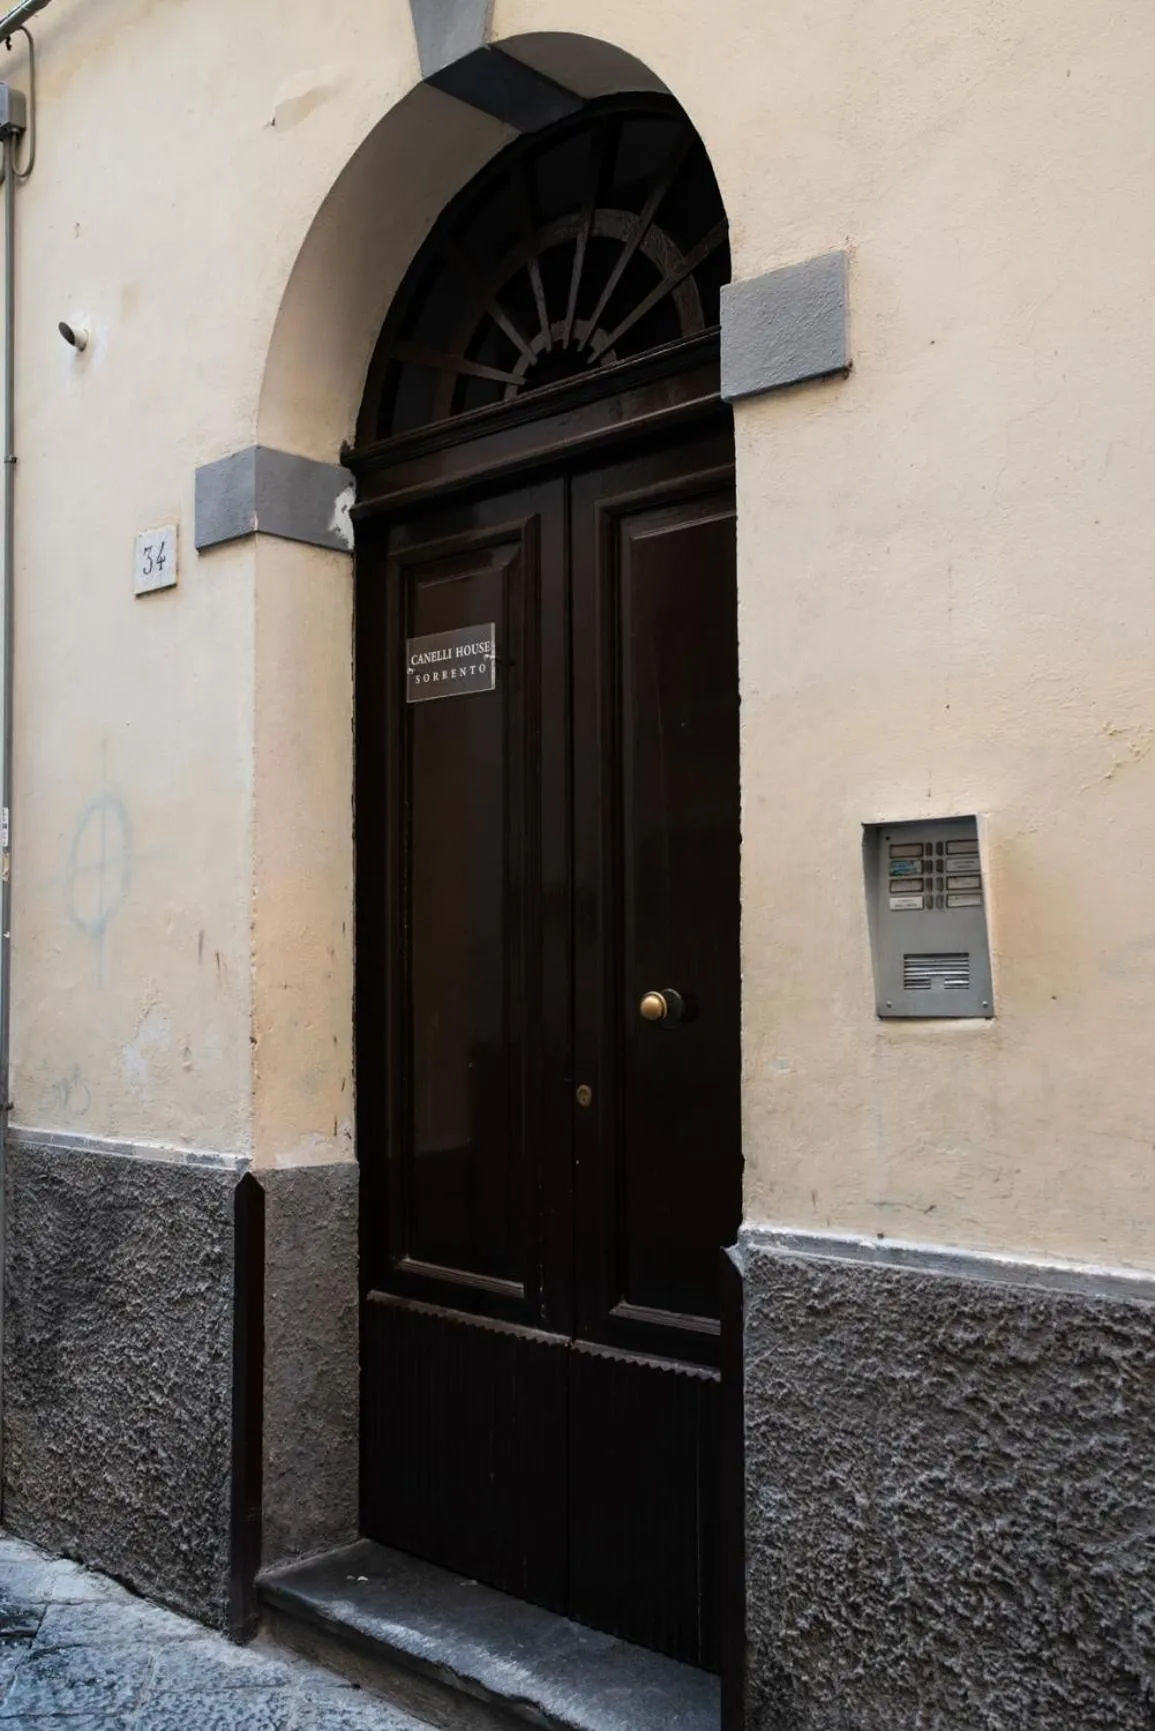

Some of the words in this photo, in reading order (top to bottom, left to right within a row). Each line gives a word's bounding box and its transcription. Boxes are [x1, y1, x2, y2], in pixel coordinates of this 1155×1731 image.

[143, 540, 168, 575] 34
[411, 648, 452, 666] CANELLI
[456, 641, 490, 658] HOUSE
[415, 663, 487, 684] SORRENTO
